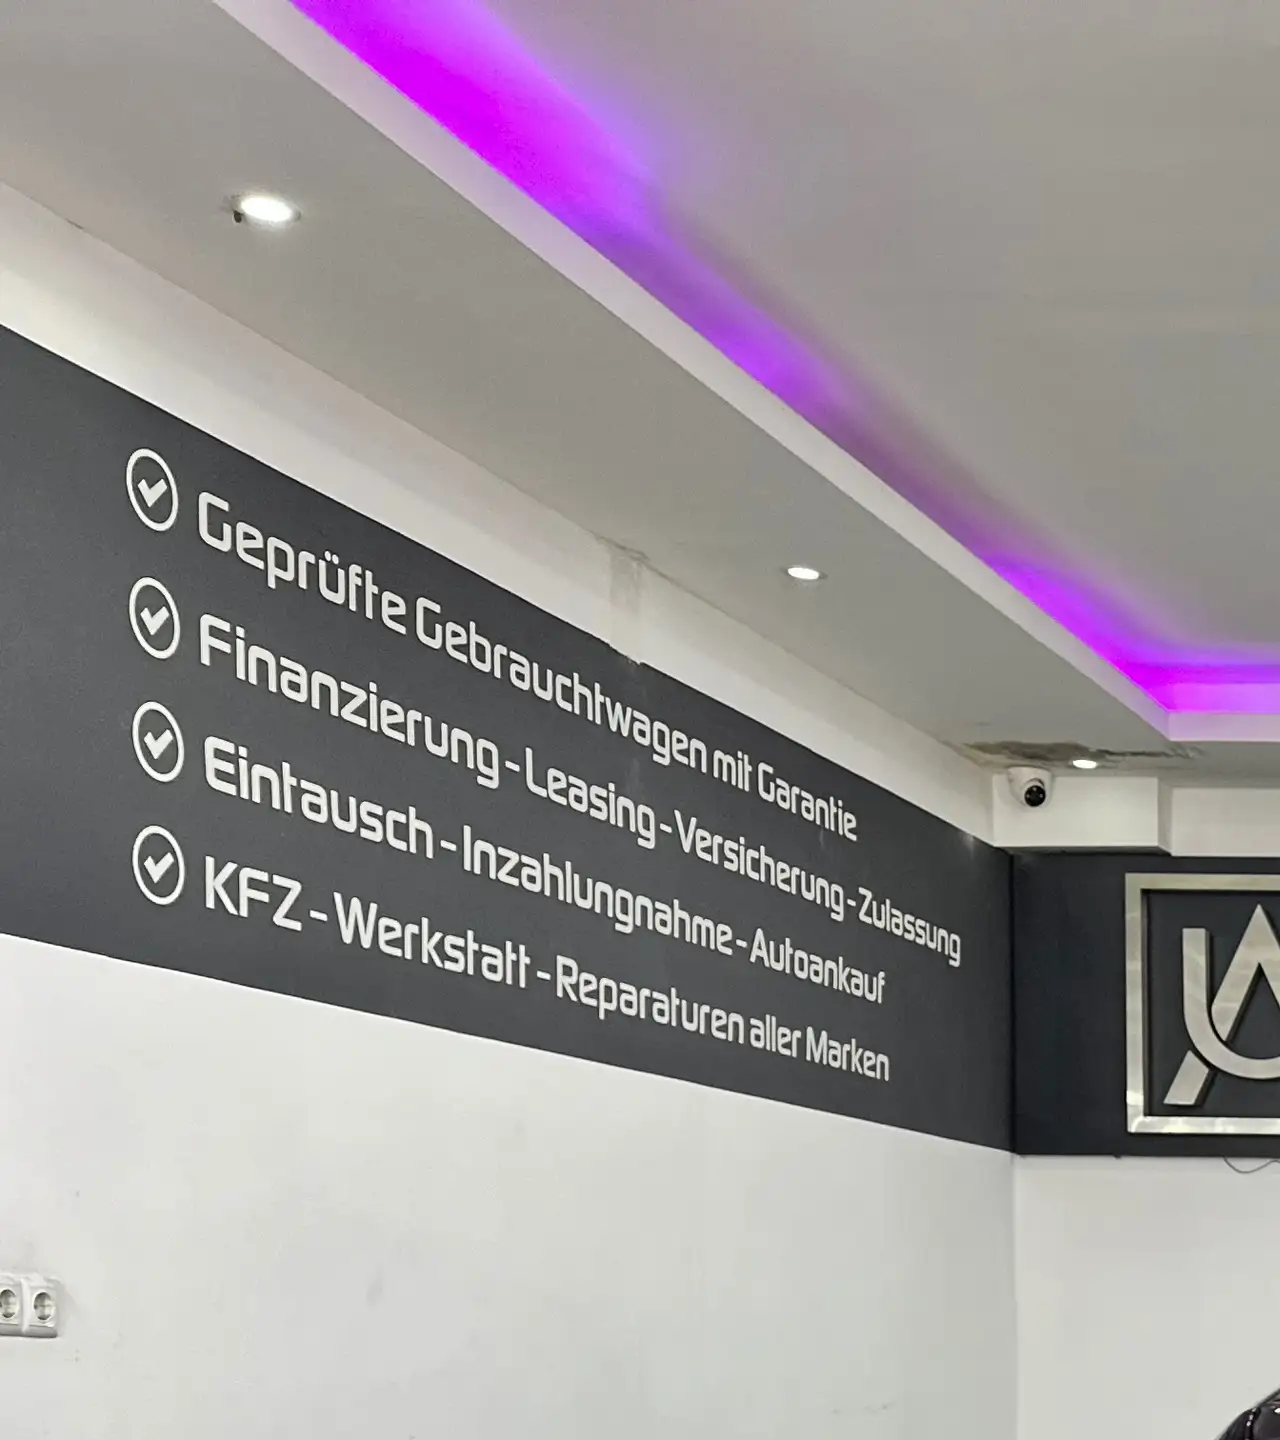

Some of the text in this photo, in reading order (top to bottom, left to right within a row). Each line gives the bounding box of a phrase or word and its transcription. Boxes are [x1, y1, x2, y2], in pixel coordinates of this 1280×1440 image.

[198, 491, 858, 841] Geprüfte Gebrauchtwagen mit Garantie
[750, 1013, 801, 1058] aller
[805, 1026, 890, 1082] Marken
